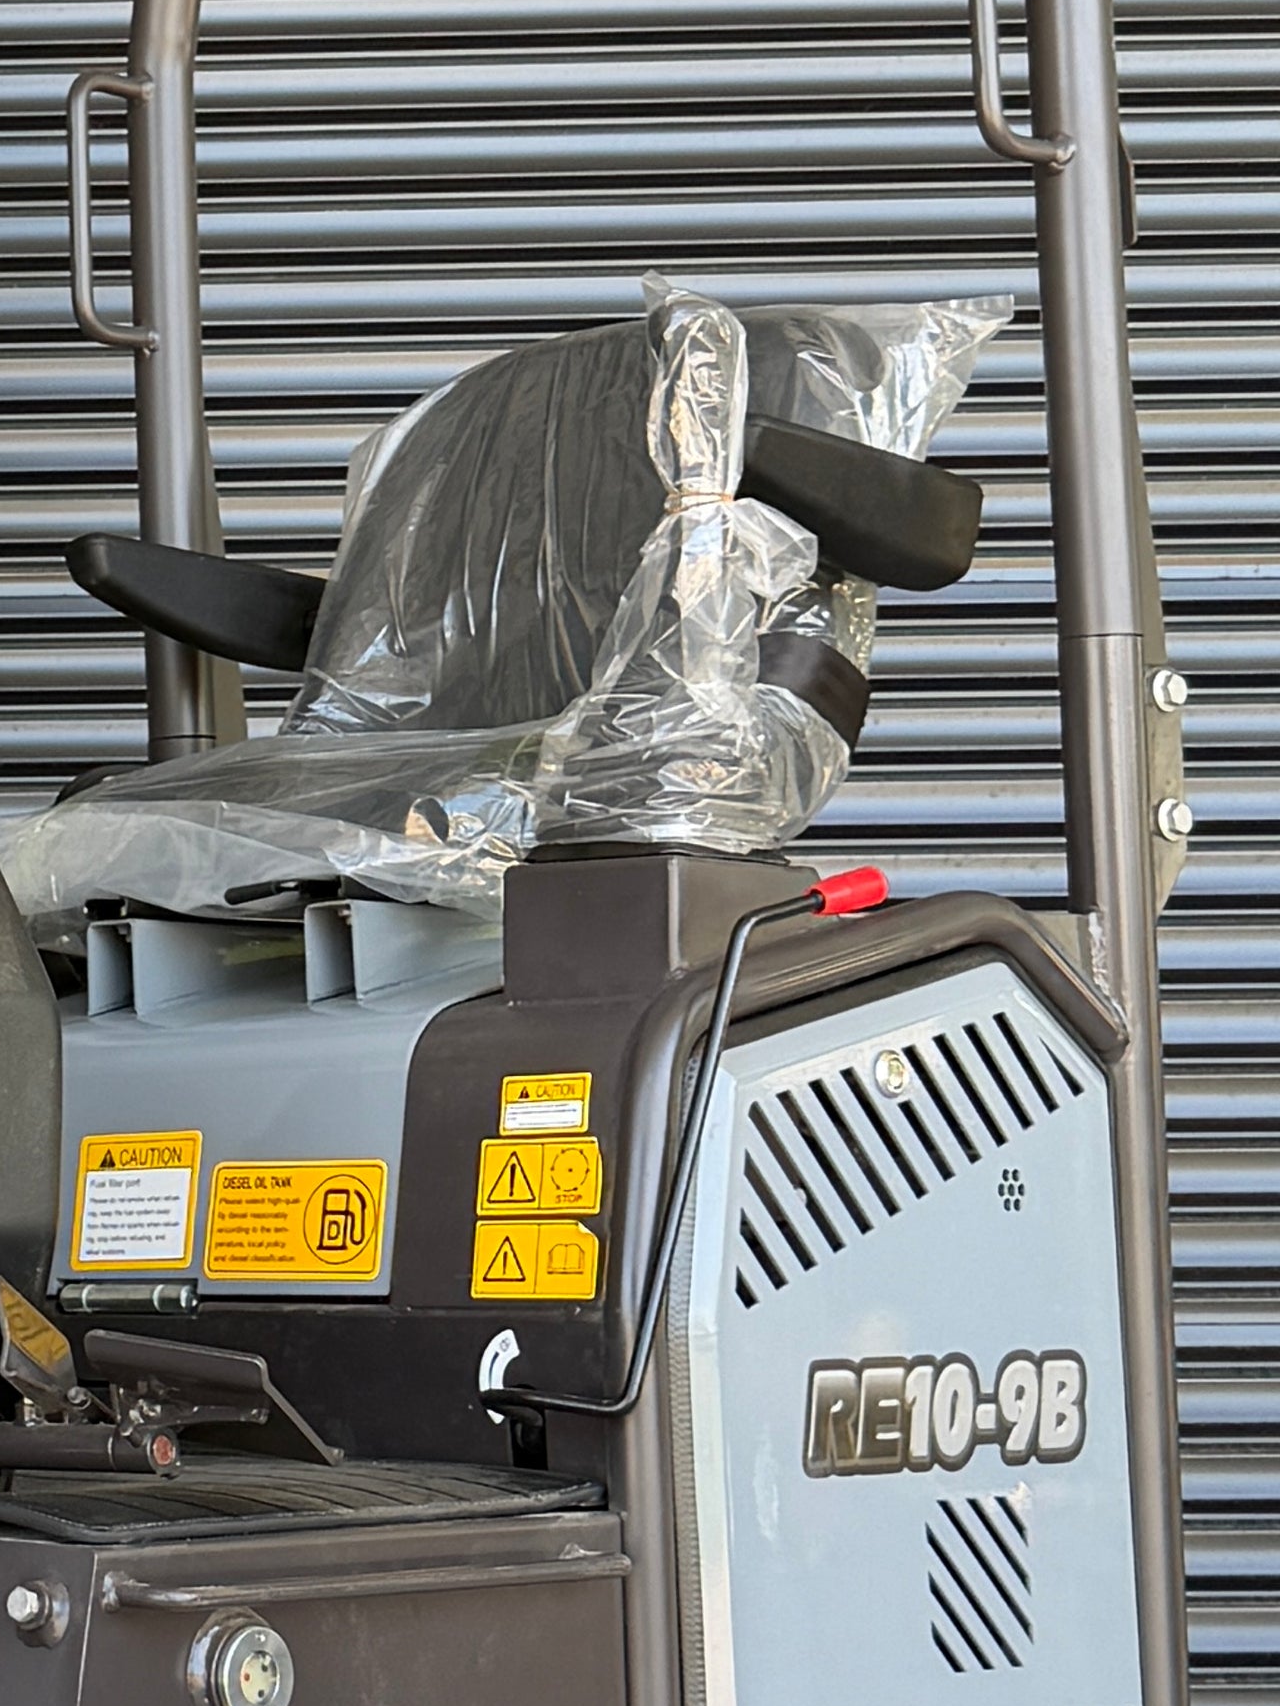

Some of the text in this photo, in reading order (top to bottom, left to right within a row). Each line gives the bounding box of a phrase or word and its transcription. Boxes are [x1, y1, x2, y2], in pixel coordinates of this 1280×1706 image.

[536, 1084, 575, 1097] CAUTION
[120, 1147, 182, 1166] CAUTION
[223, 1176, 292, 1189] DIESEL OIL TANK
[555, 1195, 582, 1203] STOP
[803, 1349, 1086, 1478] RE10-9B
